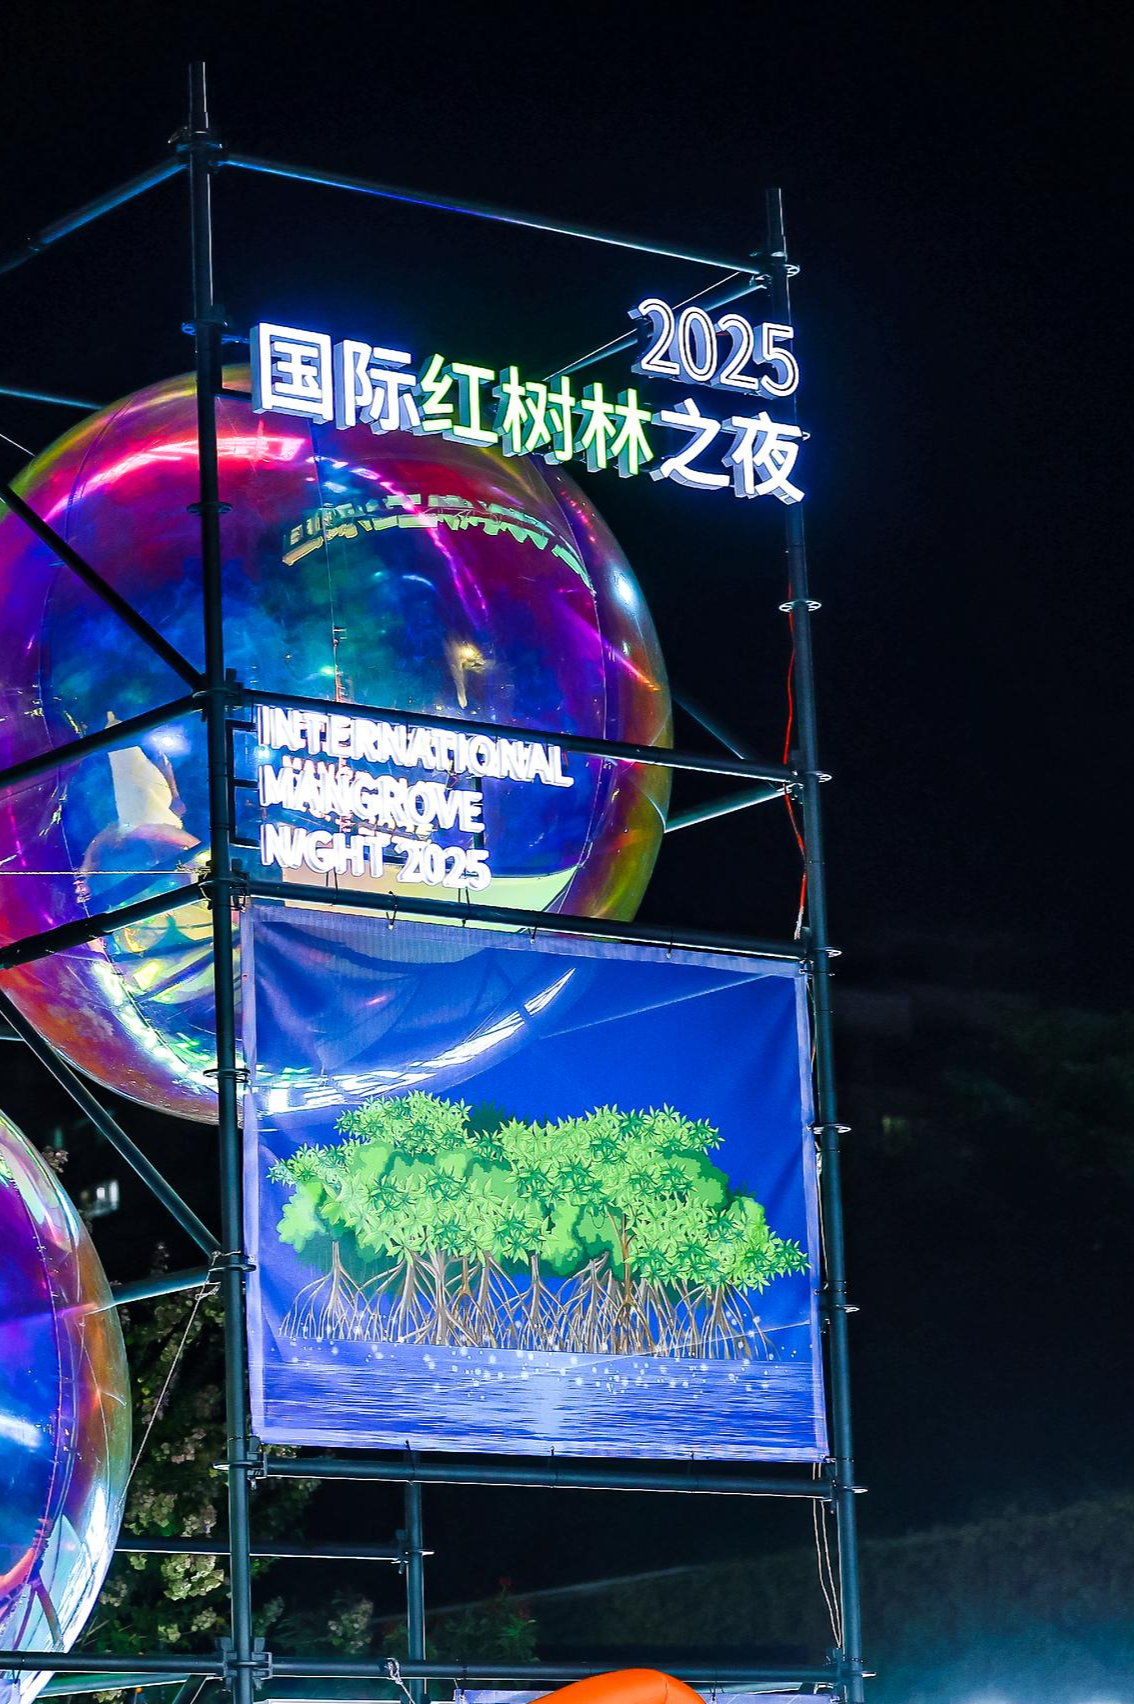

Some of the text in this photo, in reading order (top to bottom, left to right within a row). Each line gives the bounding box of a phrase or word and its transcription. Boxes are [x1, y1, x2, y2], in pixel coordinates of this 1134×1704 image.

[630, 297, 799, 399] 2025
[252, 322, 806, 505] 国际红树林之夜
[257, 704, 574, 788] INTERNATIONAL
[259, 763, 486, 834] MANGROVE
[260, 823, 493, 891] NIGHT 2025
